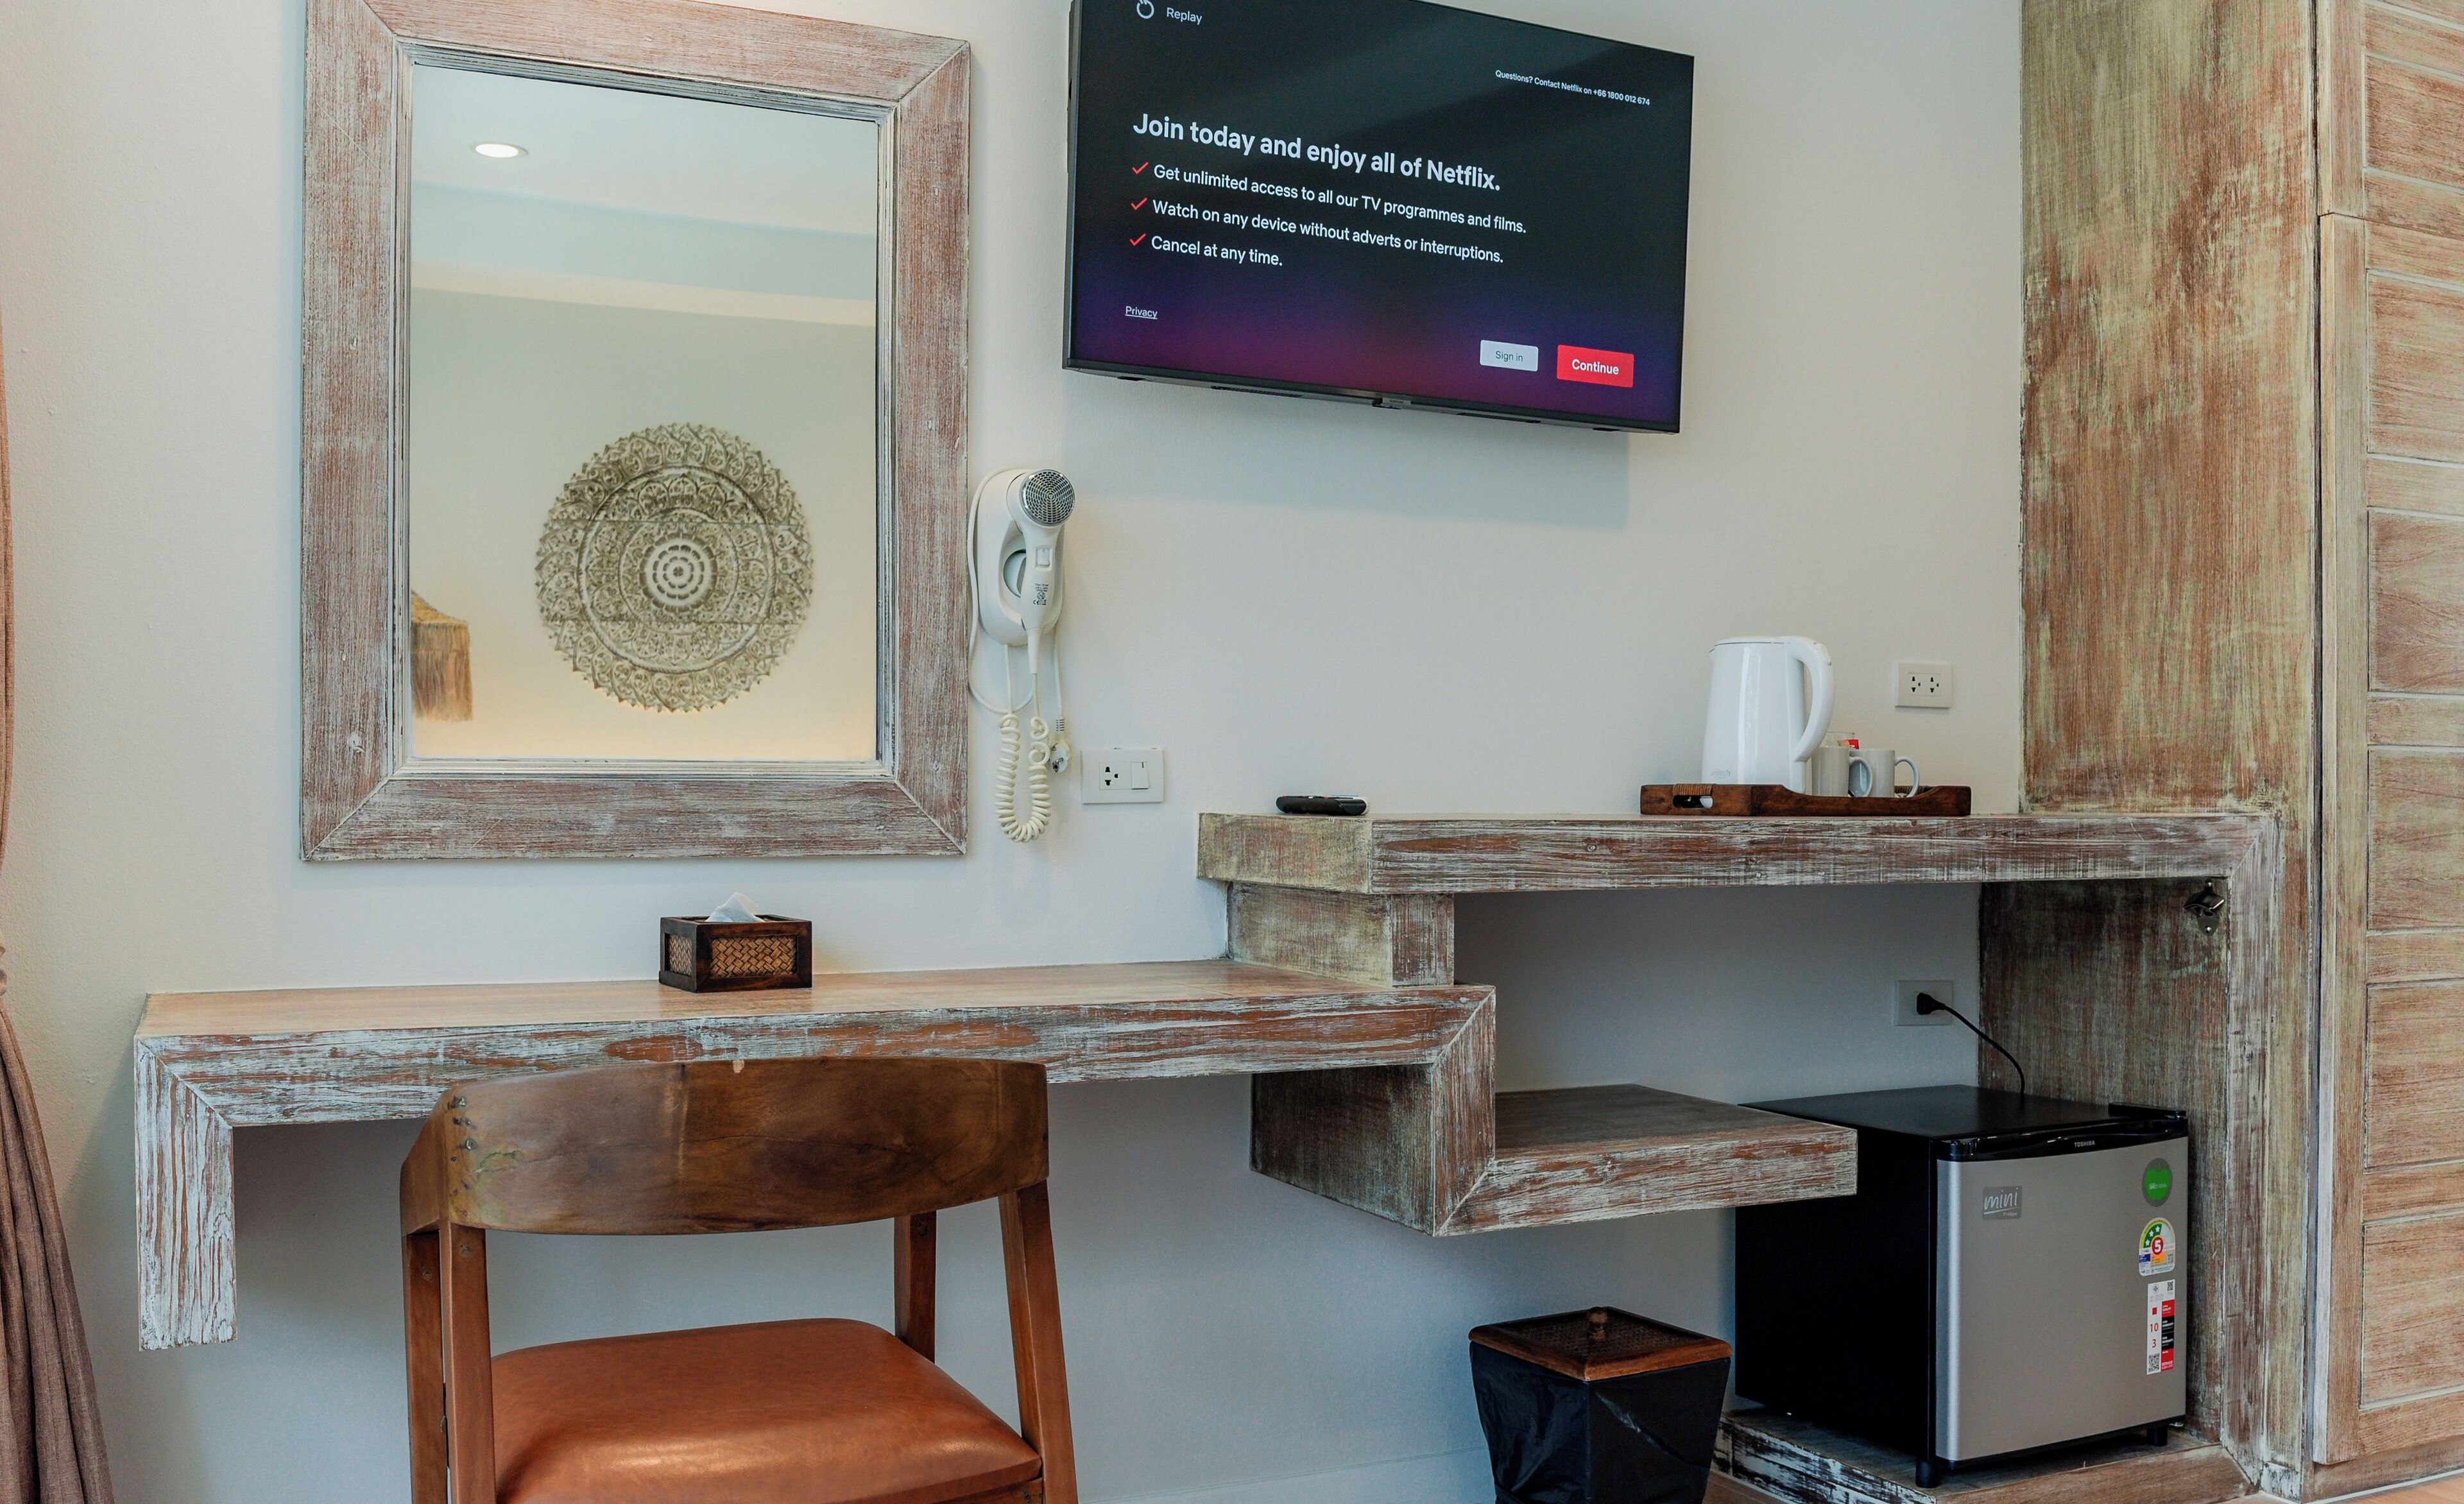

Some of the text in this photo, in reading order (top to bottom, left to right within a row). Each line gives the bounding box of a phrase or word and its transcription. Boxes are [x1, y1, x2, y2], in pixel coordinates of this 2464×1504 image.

[1167, 8, 1202, 24] Replay
[1496, 70, 1533, 83] Questions?
[1535, 78, 1560, 89] Contact
[1561, 82, 1582, 92] Netflix
[1607, 91, 1623, 100] 1800
[1638, 97, 1650, 105] 674
[1133, 114, 1500, 191] Join today and enjoy all of Netflix.
[1154, 165, 1526, 233] Get unlimited access to all our TV programmes and films.
[1153, 200, 1503, 262] Watch on any device without adverts or interruptions.
[1152, 236, 1282, 266] Cancel at any time.
[1125, 306, 1158, 319] Privacy
[1495, 350, 1523, 362] Sign in
[1572, 359, 1619, 375] Continue
[1984, 1187, 2019, 1209] mini
[2154, 1239, 2162, 1253] 5
[2150, 1322, 2159, 1333] 10
[2152, 1338, 2157, 1348] 3
